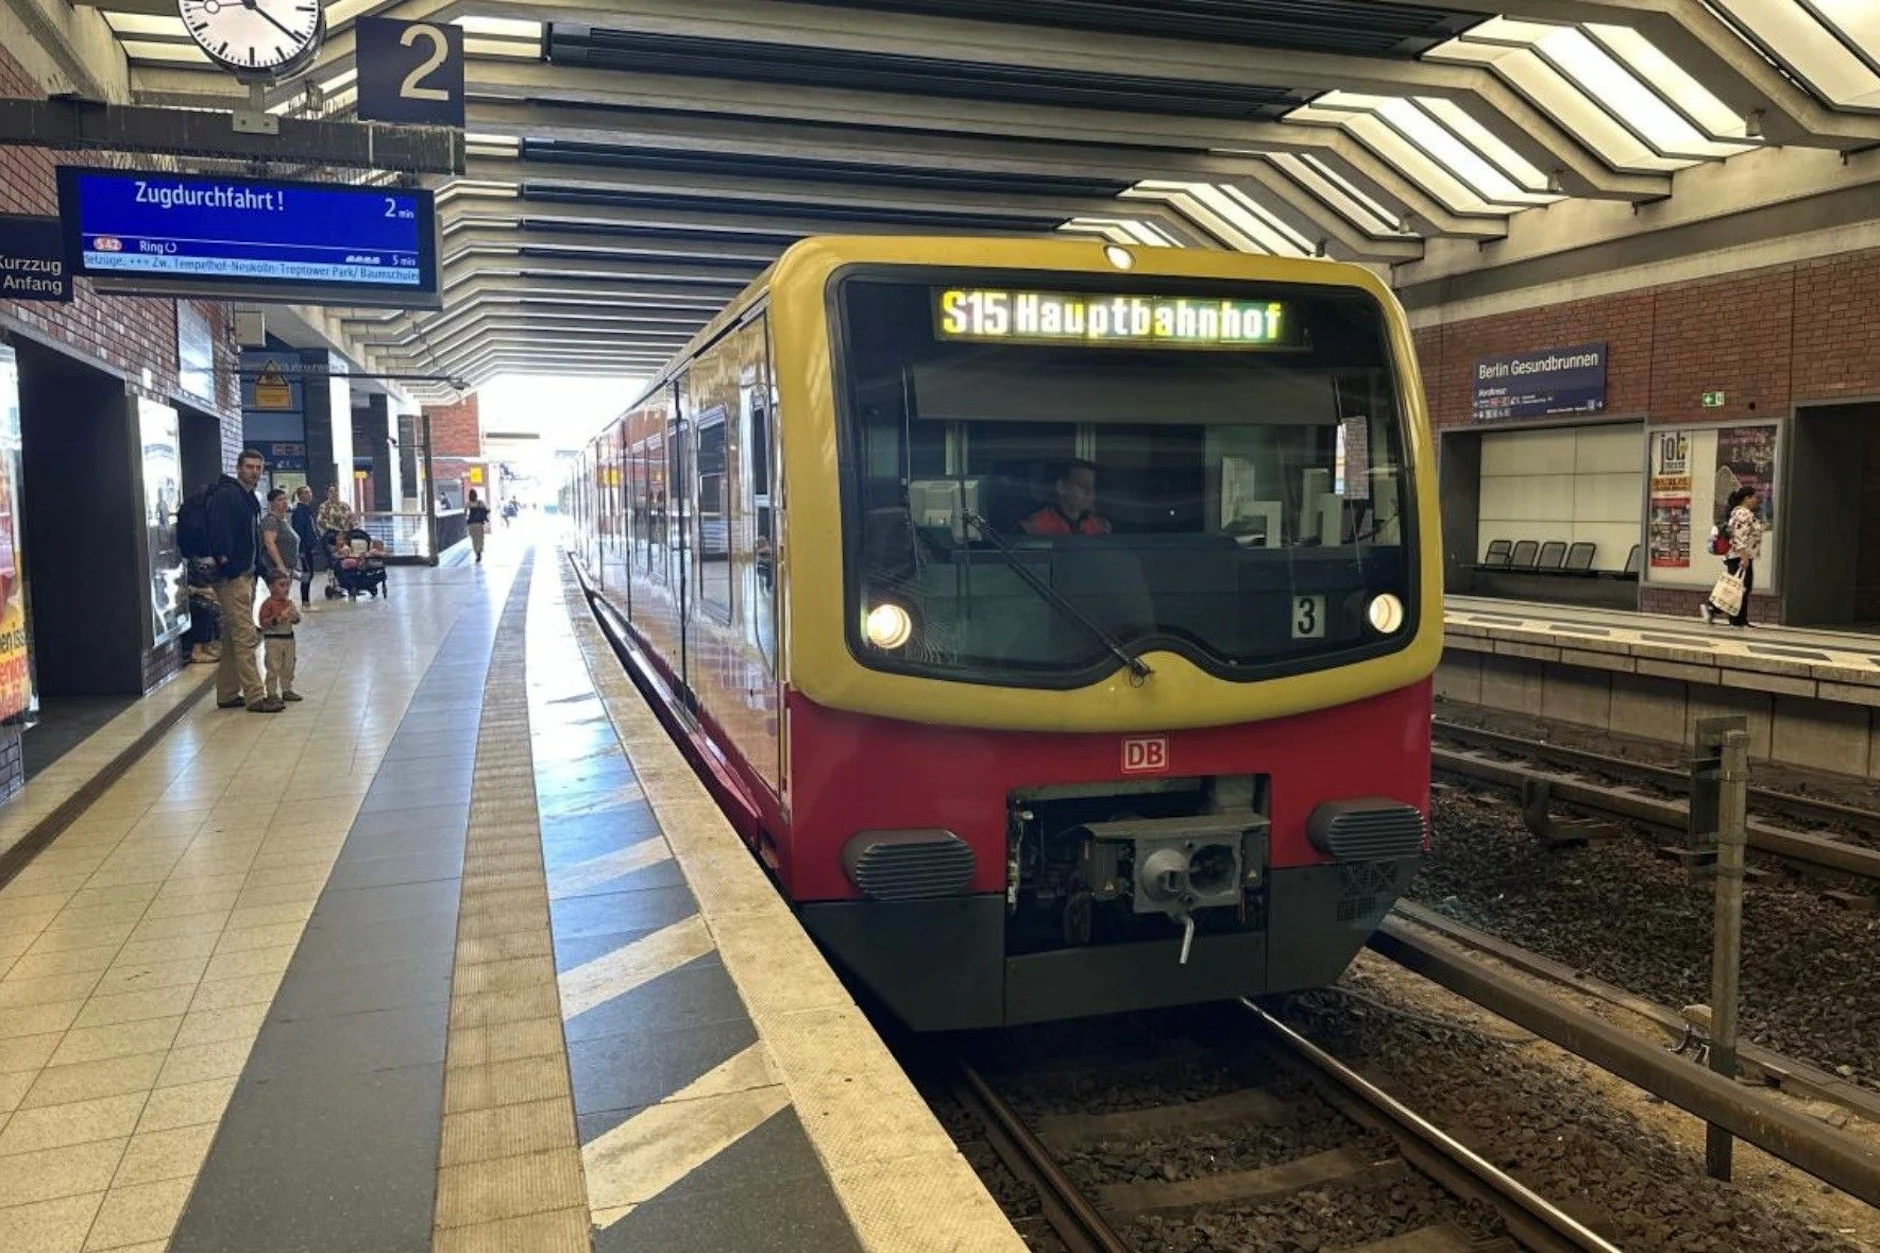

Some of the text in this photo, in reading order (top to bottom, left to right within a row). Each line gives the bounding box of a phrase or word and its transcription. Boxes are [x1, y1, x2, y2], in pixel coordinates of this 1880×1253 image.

[399, 25, 450, 101] 2
[385, 198, 415, 218] 2 min
[139, 240, 164, 254] Ring
[392, 255, 398, 265] 5
[3, 275, 62, 295] Anfang
[943, 290, 1282, 339] S15 Hauptbahnhof
[1479, 353, 1599, 379] Berlin Gesundbrunnen
[1297, 599, 1315, 636] 3
[1126, 741, 1165, 767] DB
